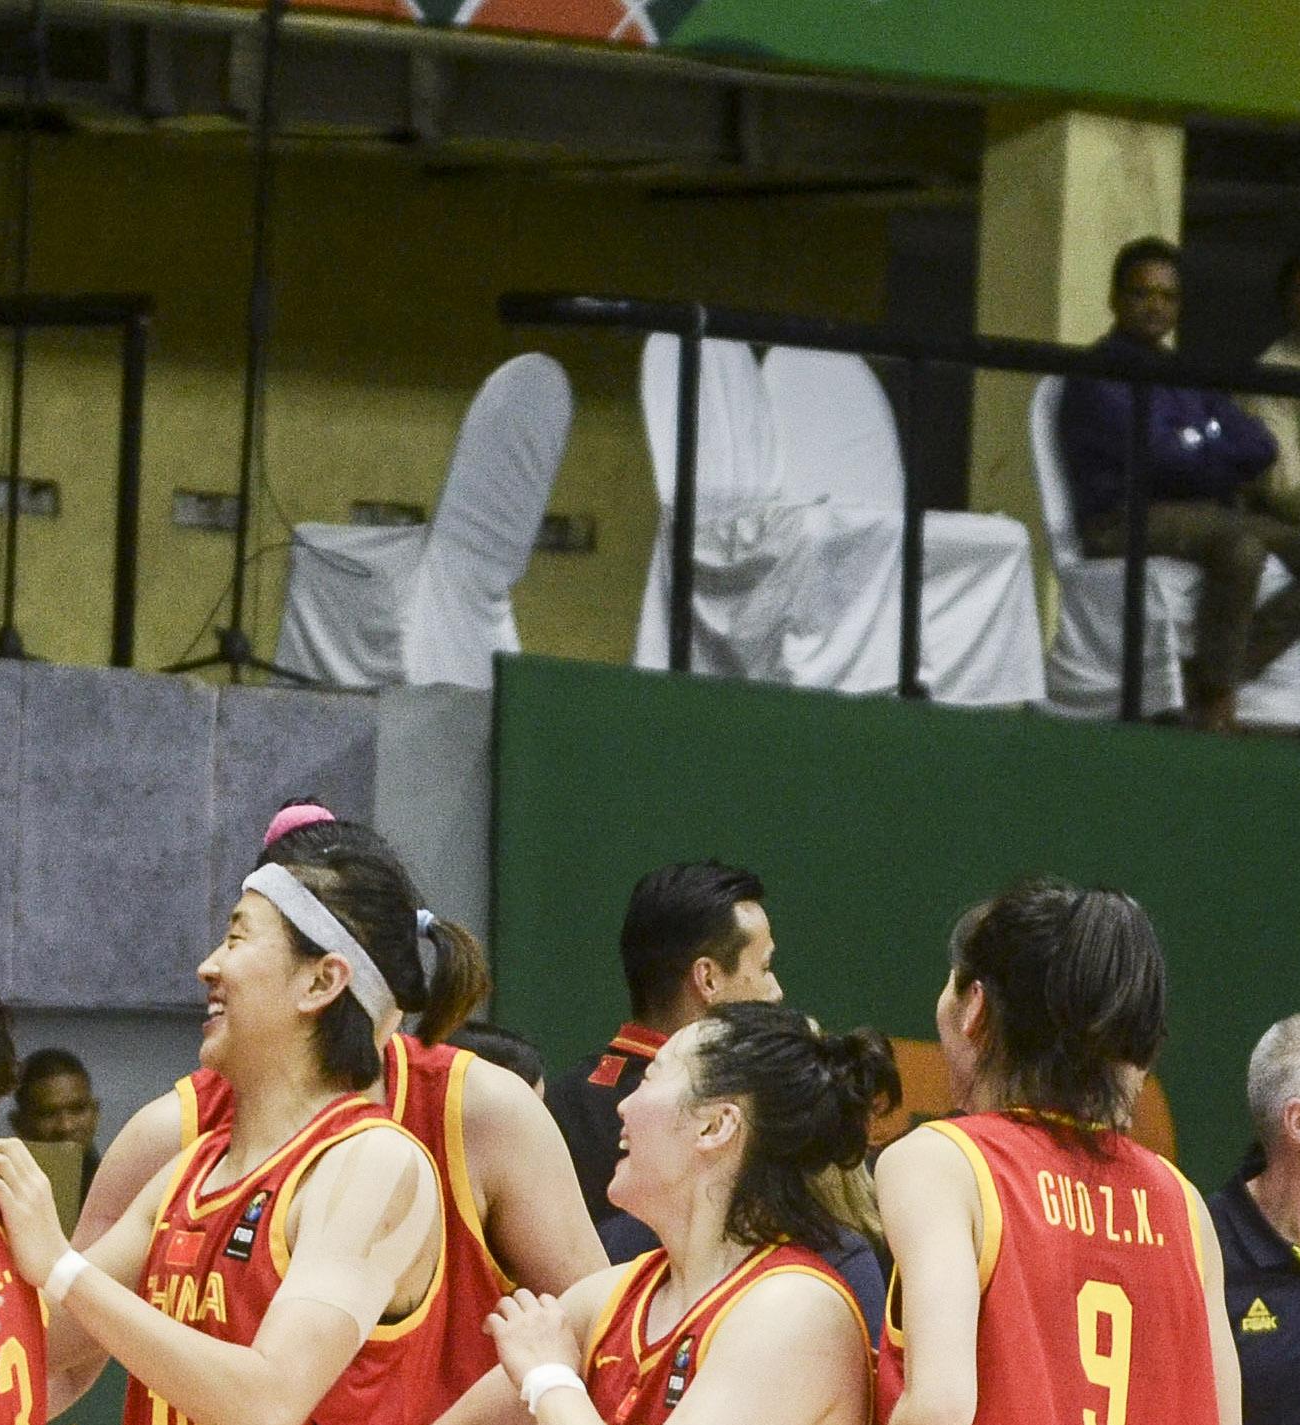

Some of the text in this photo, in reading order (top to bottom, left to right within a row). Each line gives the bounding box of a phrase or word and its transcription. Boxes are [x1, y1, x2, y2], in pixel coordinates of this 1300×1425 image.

[1037, 1170, 1165, 1248] GUO Z.X.
[147, 1271, 228, 1324] HINA
